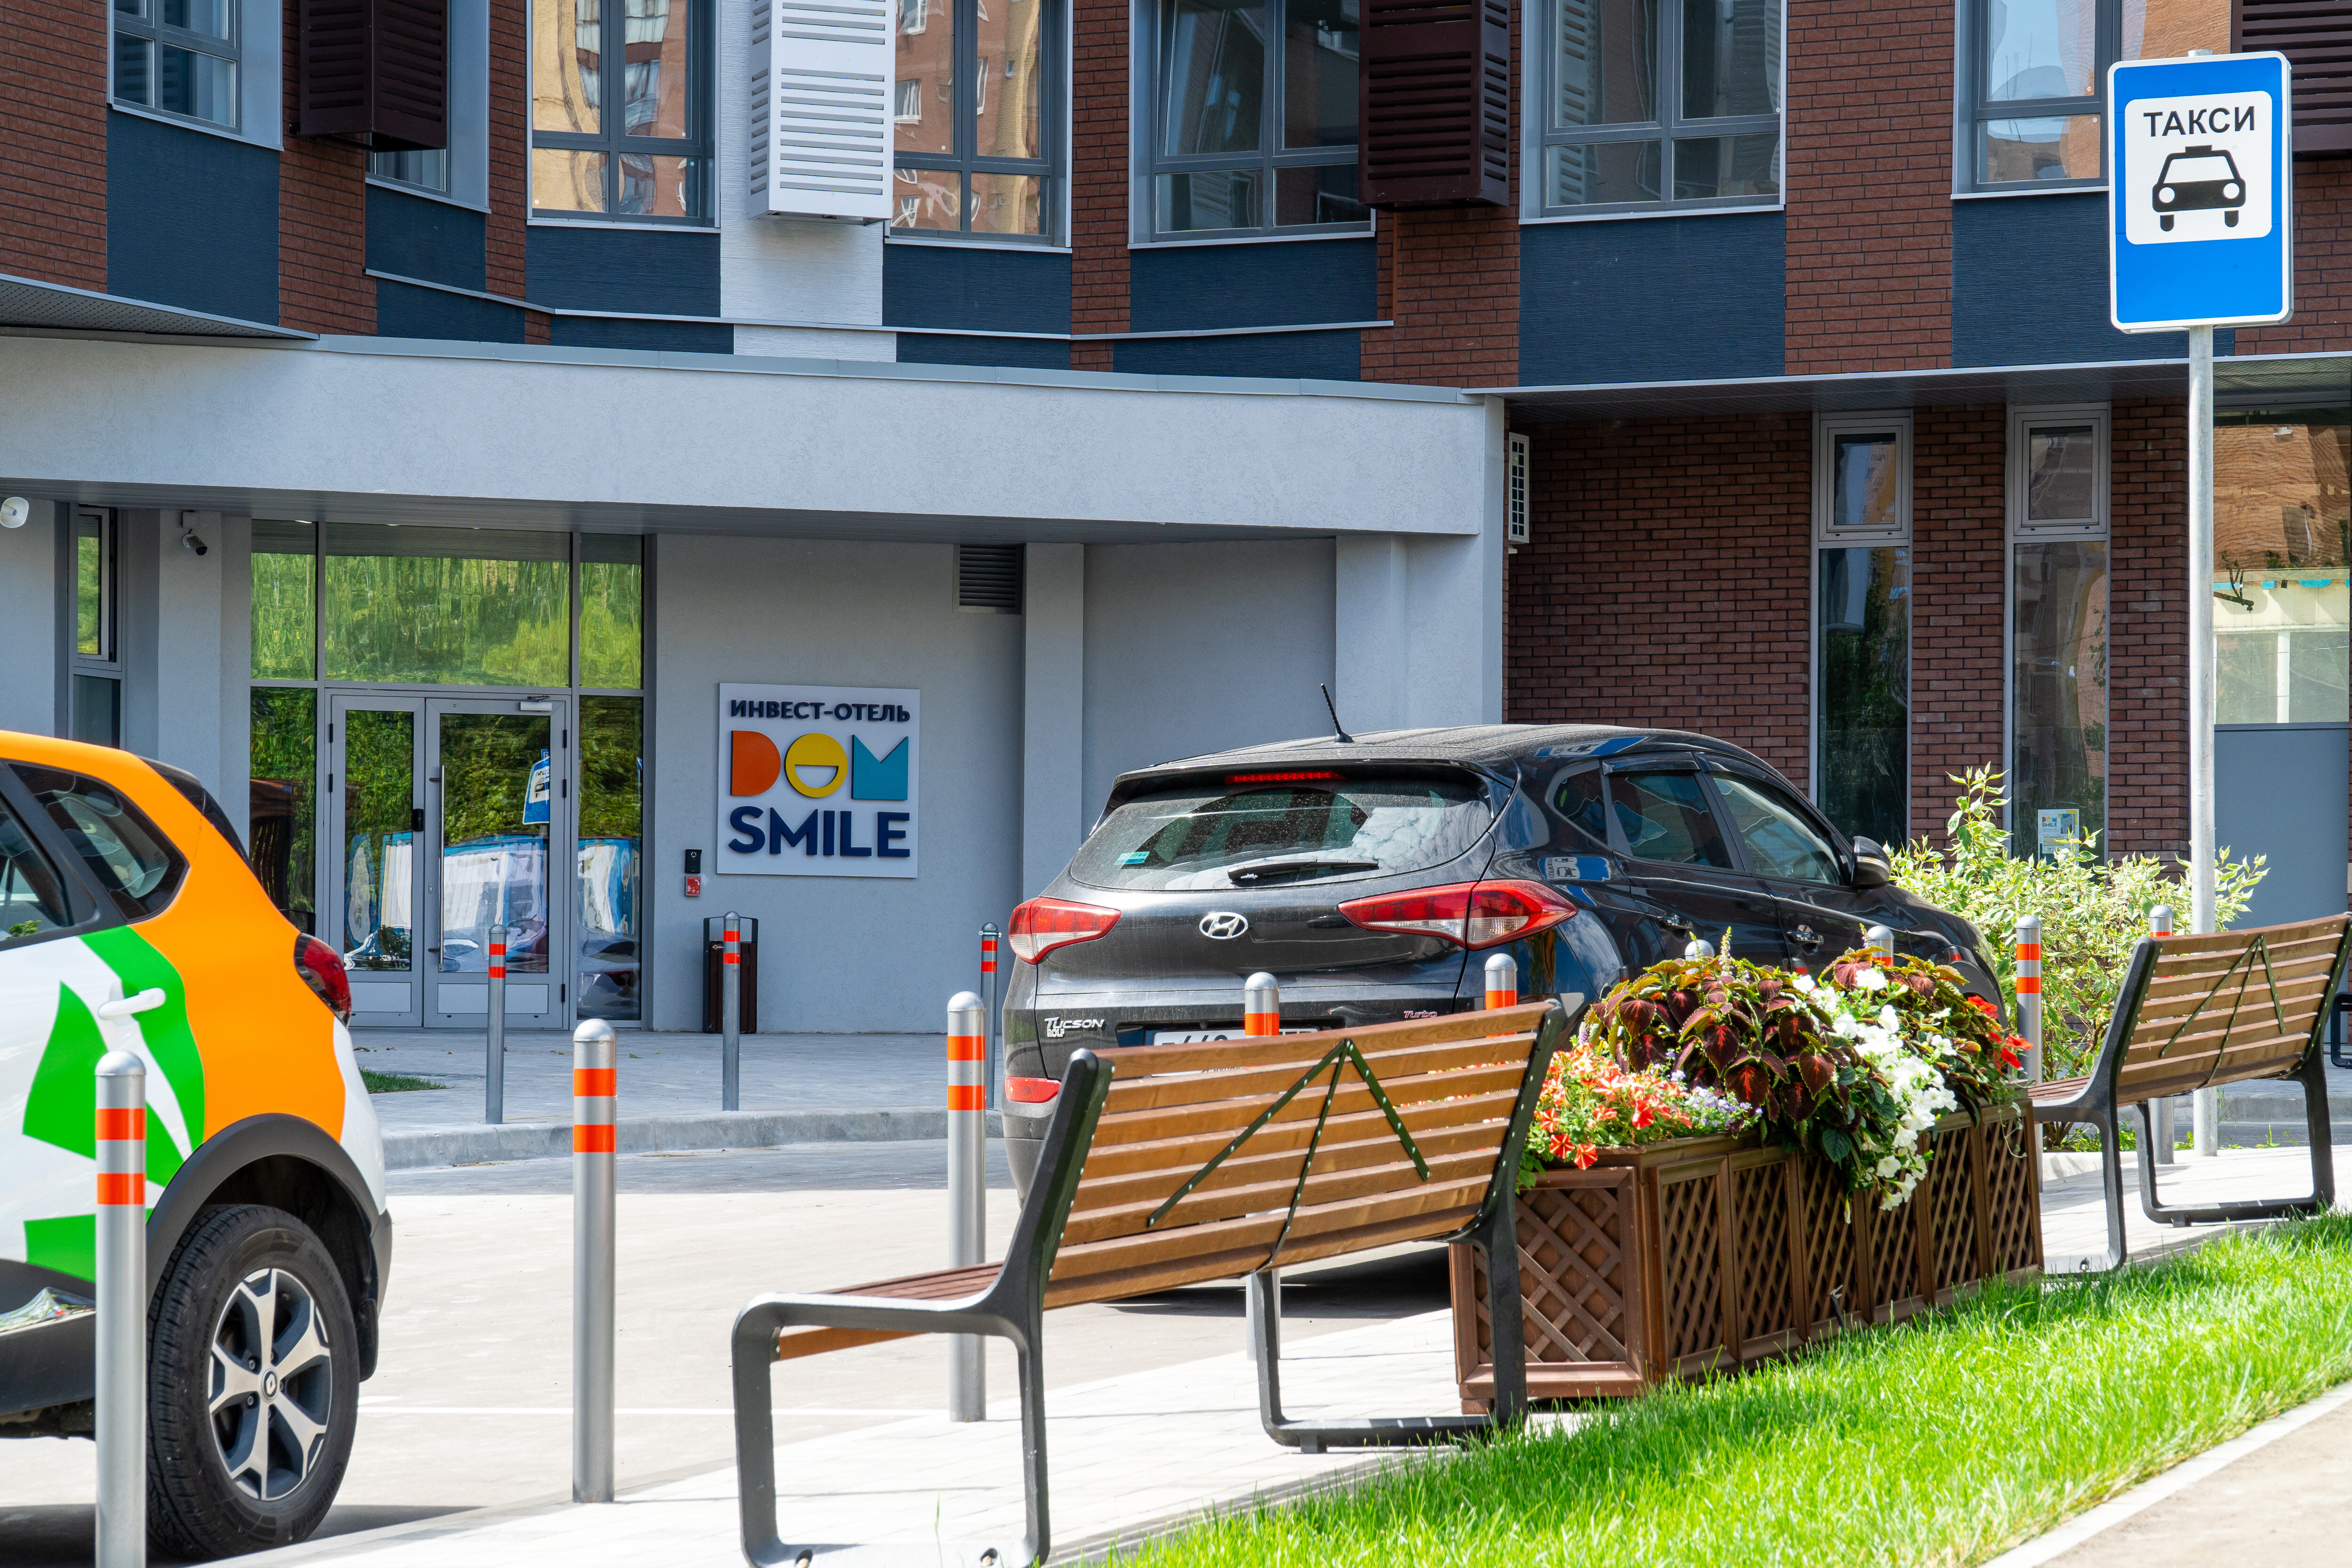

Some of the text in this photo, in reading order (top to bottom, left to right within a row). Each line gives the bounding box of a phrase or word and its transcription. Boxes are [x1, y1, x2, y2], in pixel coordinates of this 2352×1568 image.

[2143, 106, 2255, 137] ТАКСИ
[730, 699, 911, 722] ИНВЕСТ-ОТЕЛЬ
[730, 730, 909, 800] DOM
[728, 805, 911, 857] SMILE
[1047, 1028, 1065, 1038] ROLF
